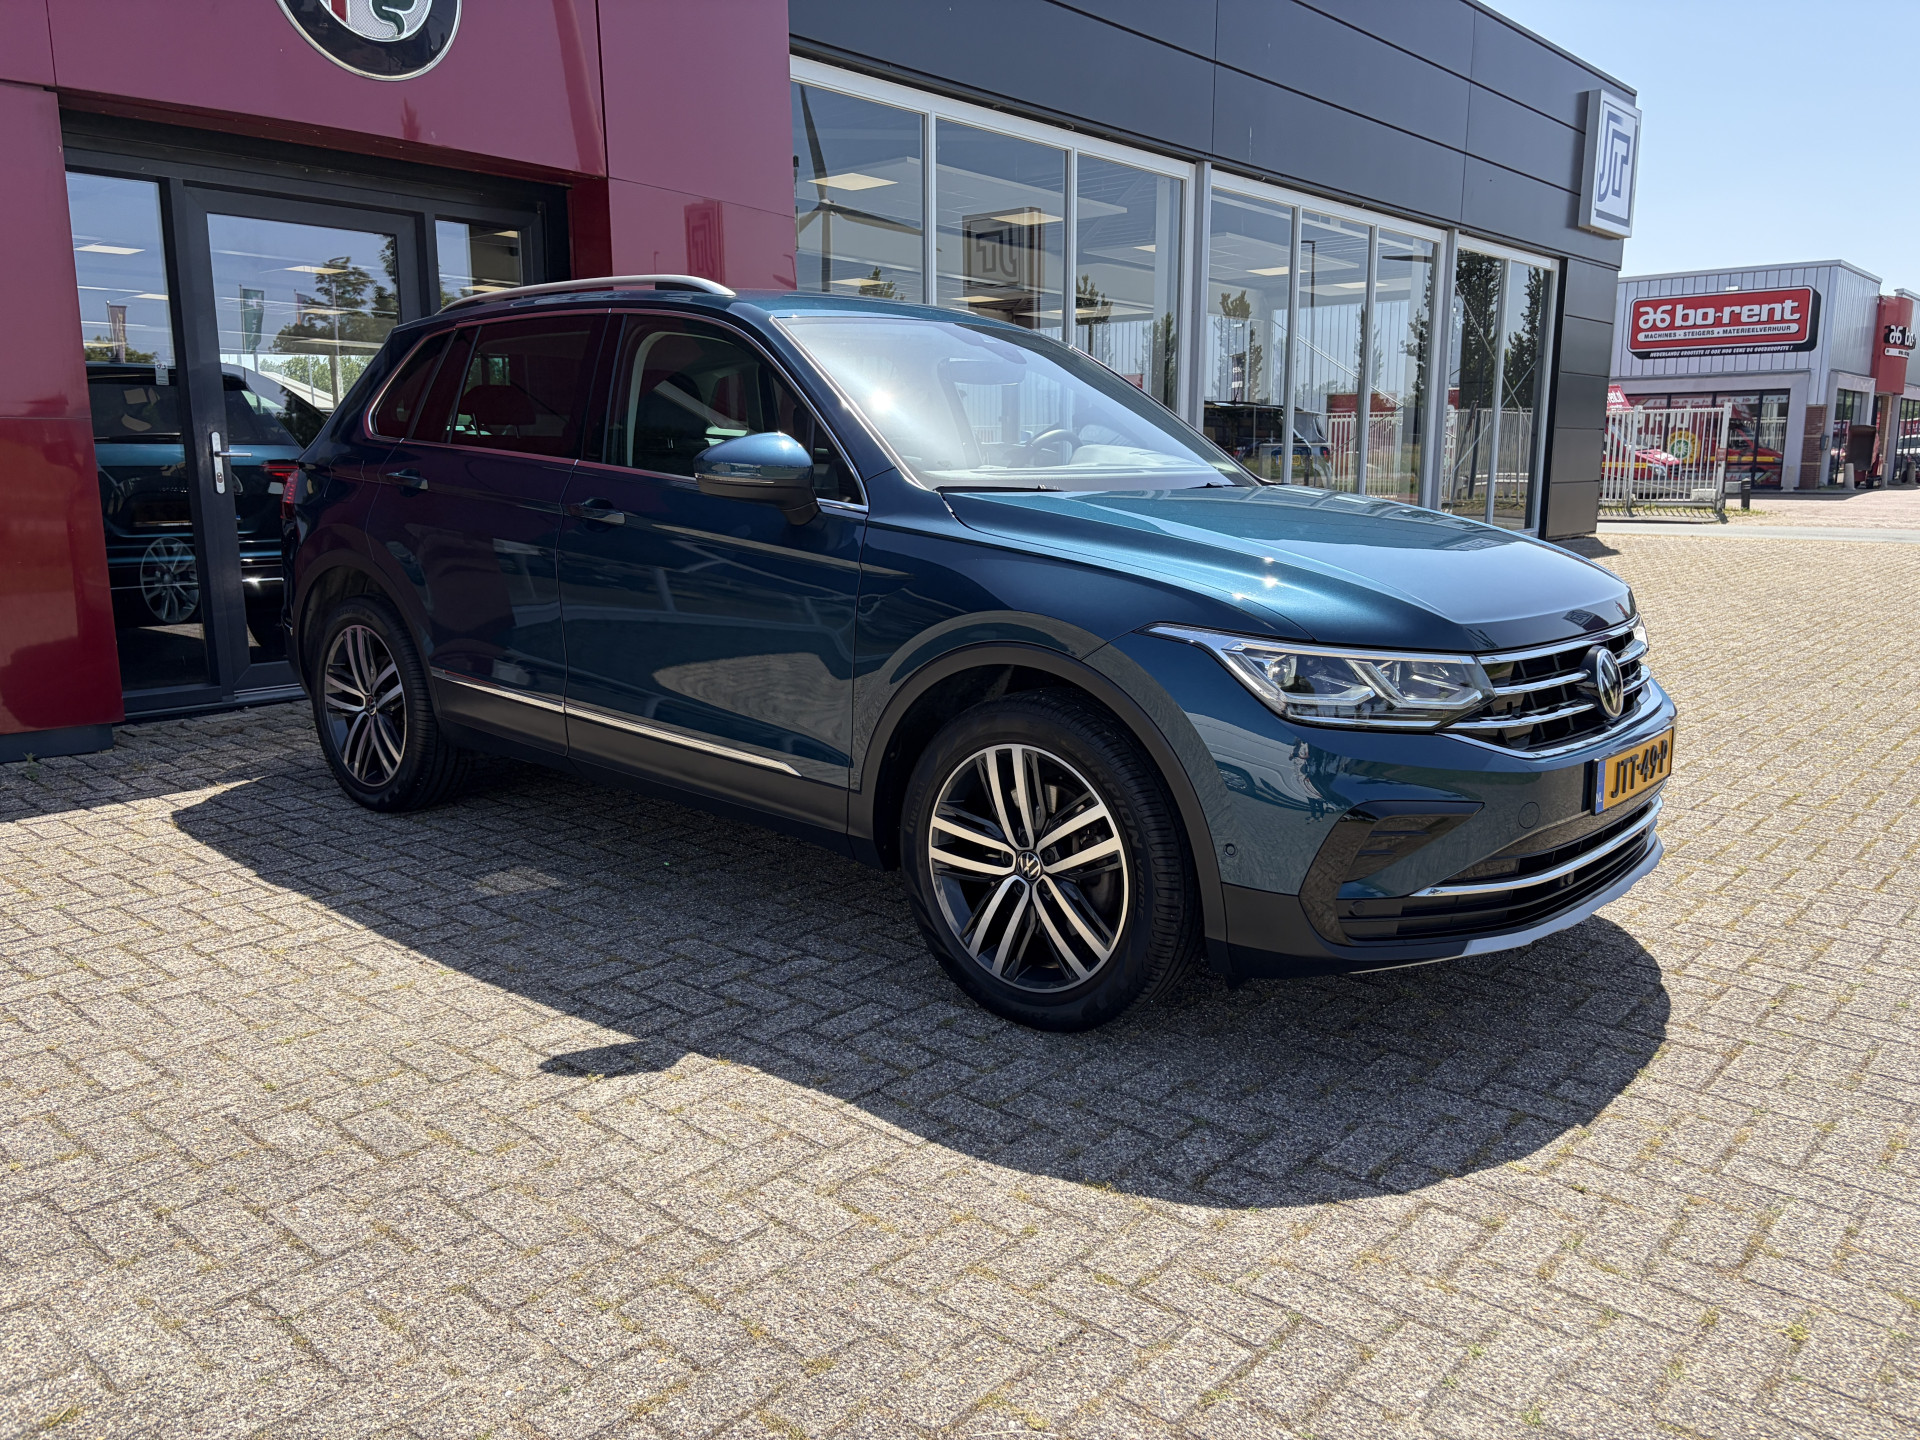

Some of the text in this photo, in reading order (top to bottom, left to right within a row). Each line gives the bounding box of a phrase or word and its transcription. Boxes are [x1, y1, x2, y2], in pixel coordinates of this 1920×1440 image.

[1643, 325, 1791, 340] MACHINES STEIGERS MATERIEELVERHUUR
[1611, 739, 1668, 798] JTT-49-P
